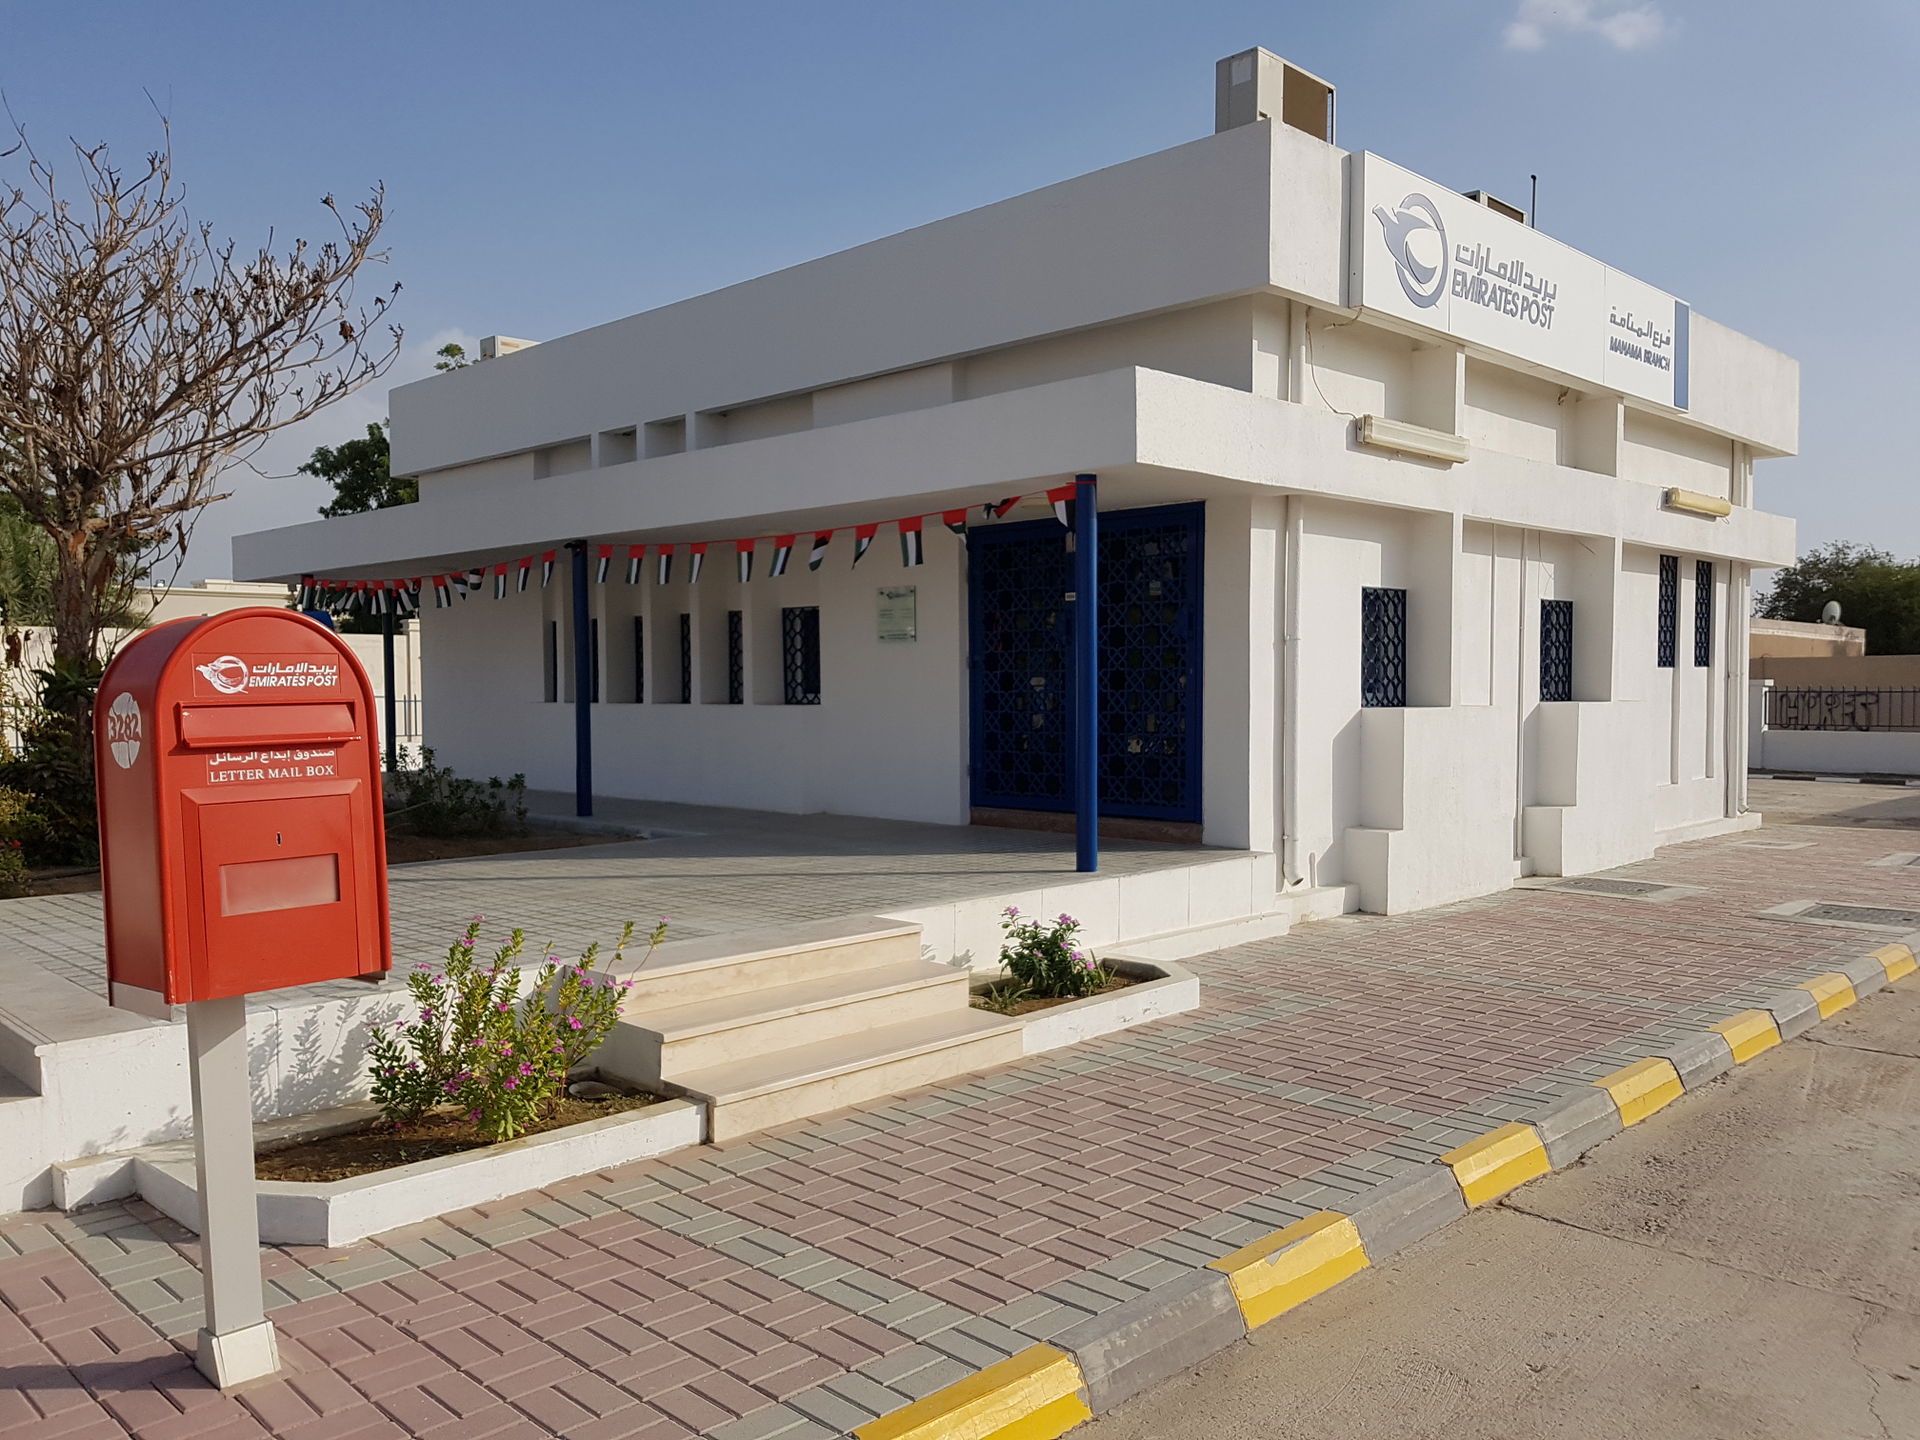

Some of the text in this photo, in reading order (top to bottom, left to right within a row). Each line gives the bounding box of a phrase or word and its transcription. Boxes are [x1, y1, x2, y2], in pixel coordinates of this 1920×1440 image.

[1451, 268, 1555, 330] EMIRATES POST
[1523, 271, 1557, 304] بريد
[1609, 305, 1671, 349] فرع المنامة
[1609, 336, 1671, 372] MANAMA BRANCH
[248, 675, 338, 688] EMIRATES POST
[308, 664, 337, 676] بريد
[108, 711, 142, 742] 3282
[209, 751, 258, 765] الرسائل
[210, 765, 335, 783] LETTER MAIL BOX
